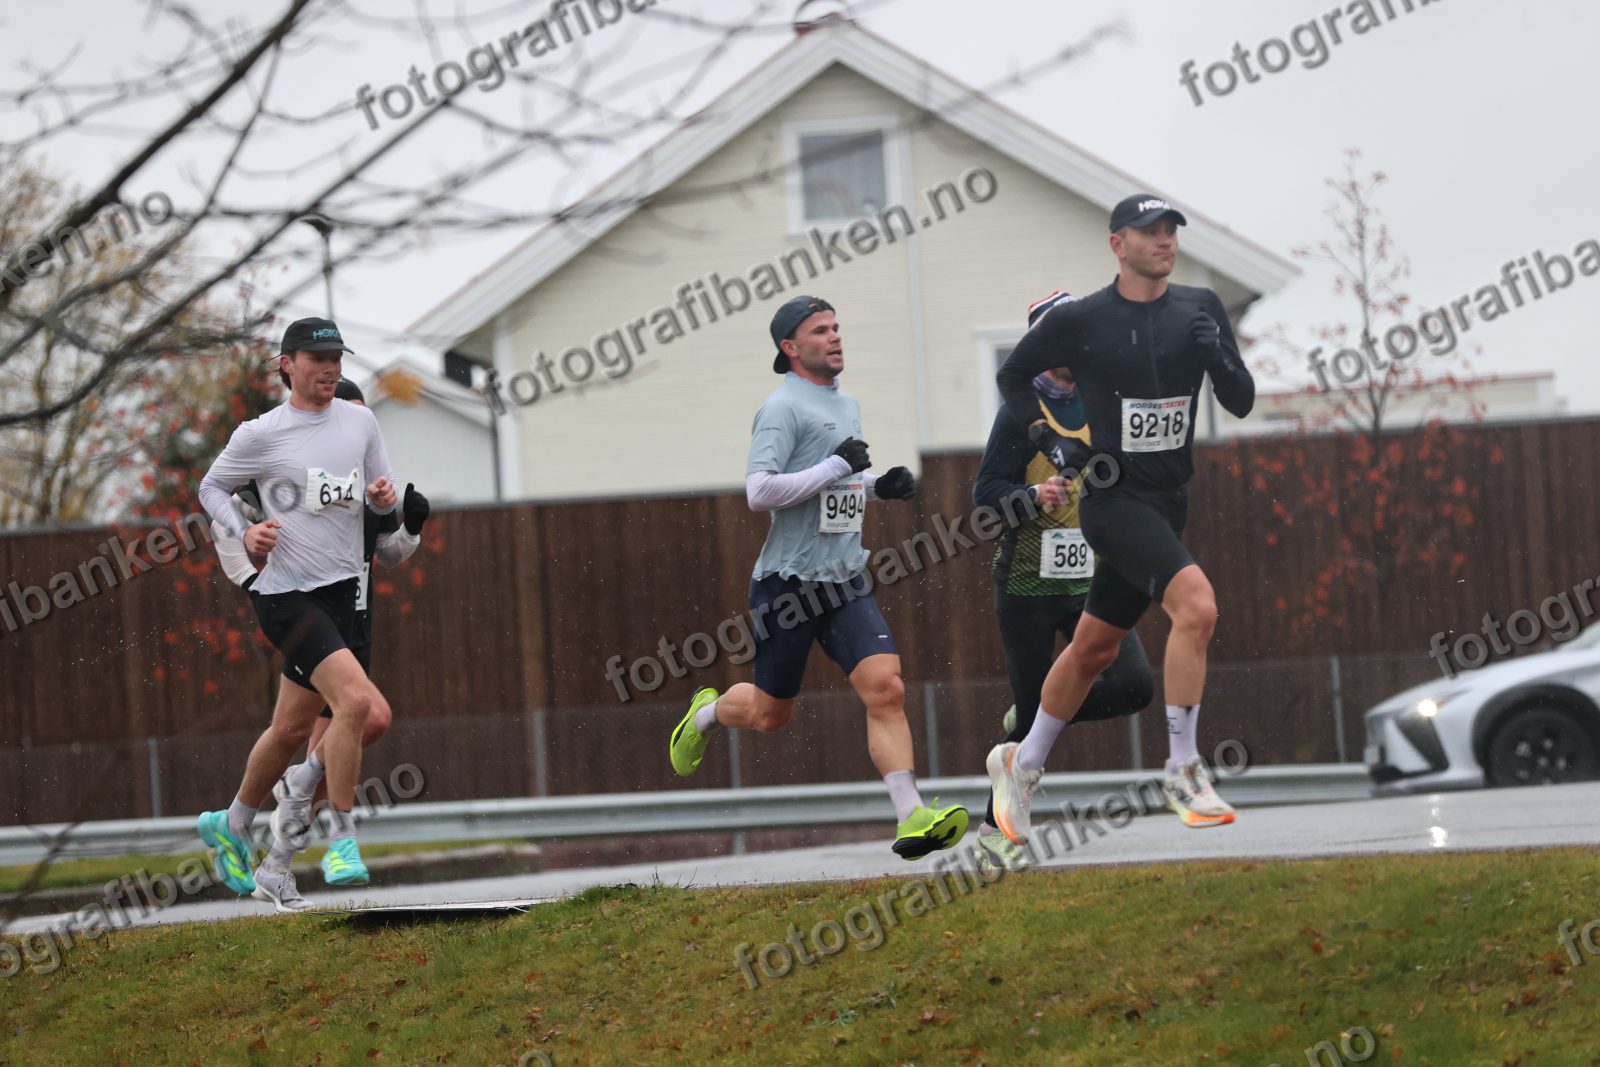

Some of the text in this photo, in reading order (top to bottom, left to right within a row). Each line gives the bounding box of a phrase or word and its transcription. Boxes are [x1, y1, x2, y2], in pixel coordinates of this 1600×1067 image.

[1130, 411, 1184, 439] 9218
[320, 483, 354, 506] 614
[826, 494, 863, 520] 9494
[1054, 543, 1087, 568] 589
